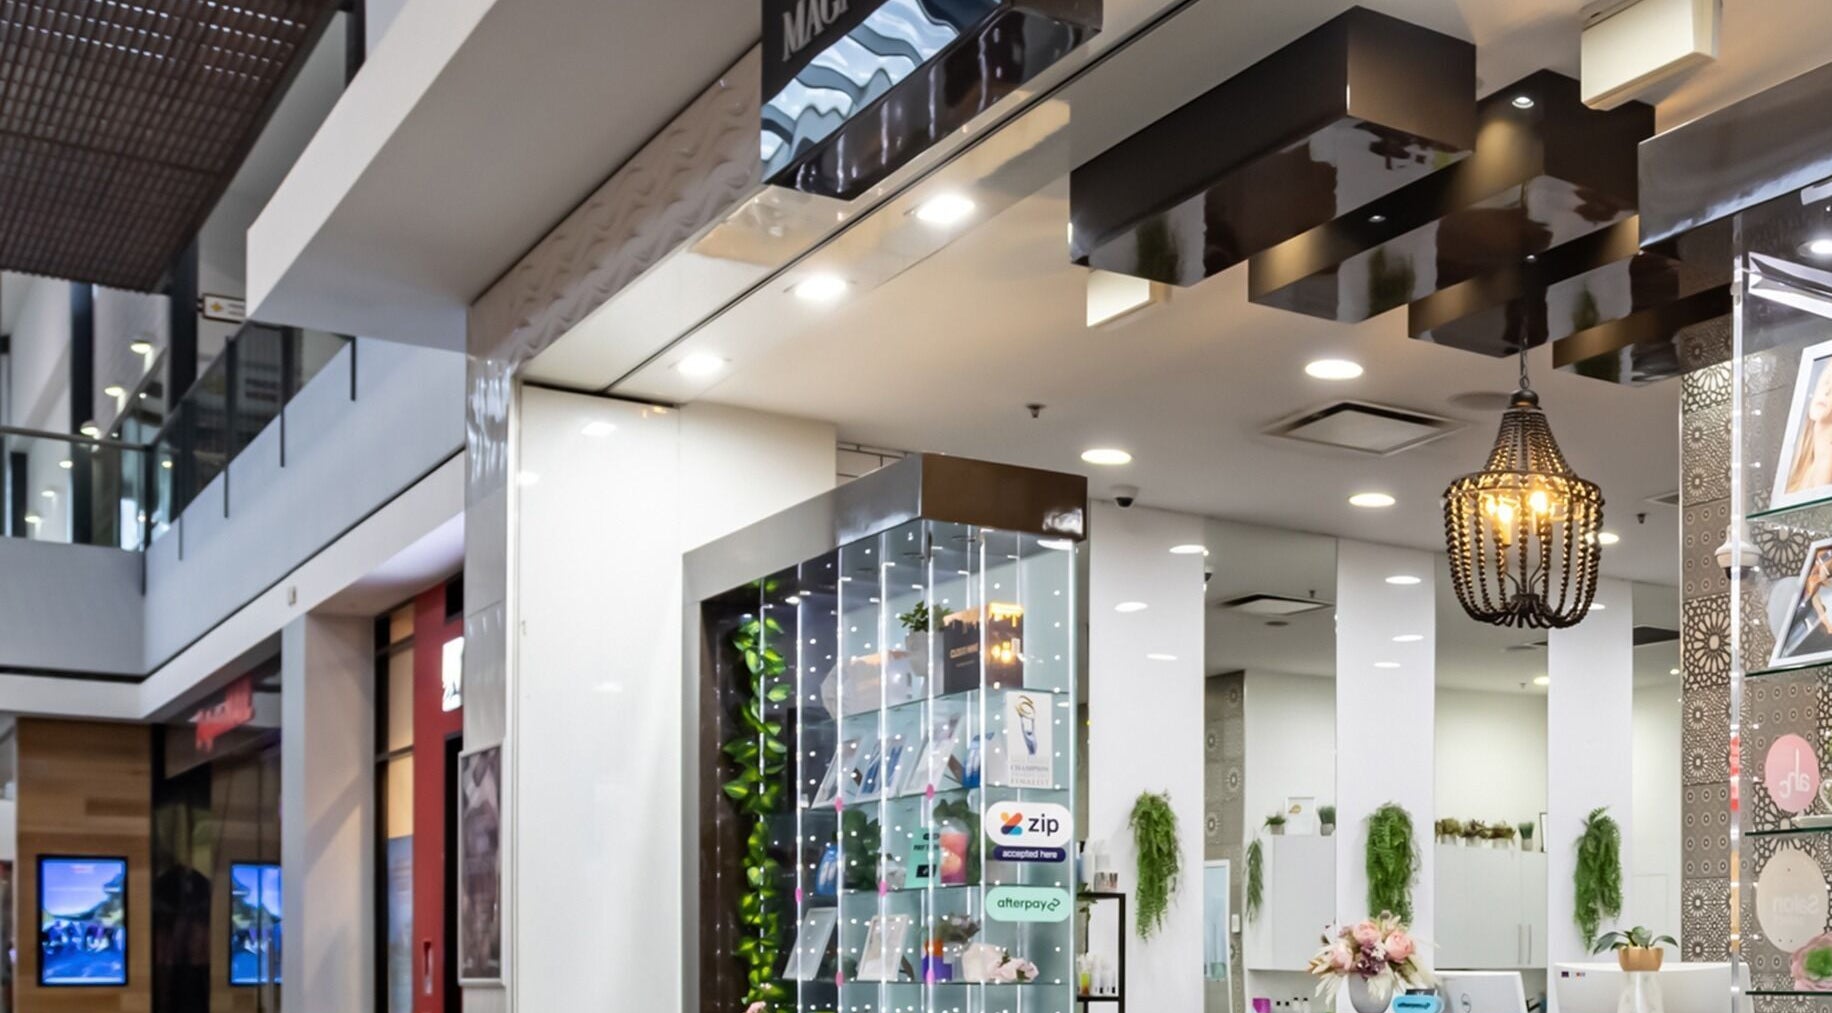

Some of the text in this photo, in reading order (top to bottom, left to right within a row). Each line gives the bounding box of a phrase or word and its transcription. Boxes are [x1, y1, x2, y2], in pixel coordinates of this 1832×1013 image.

[782, 0, 848, 61] MAG
[1028, 813, 1059, 837] zip
[1002, 849, 1058, 860] accepted here
[997, 898, 1047, 911] afterpay
